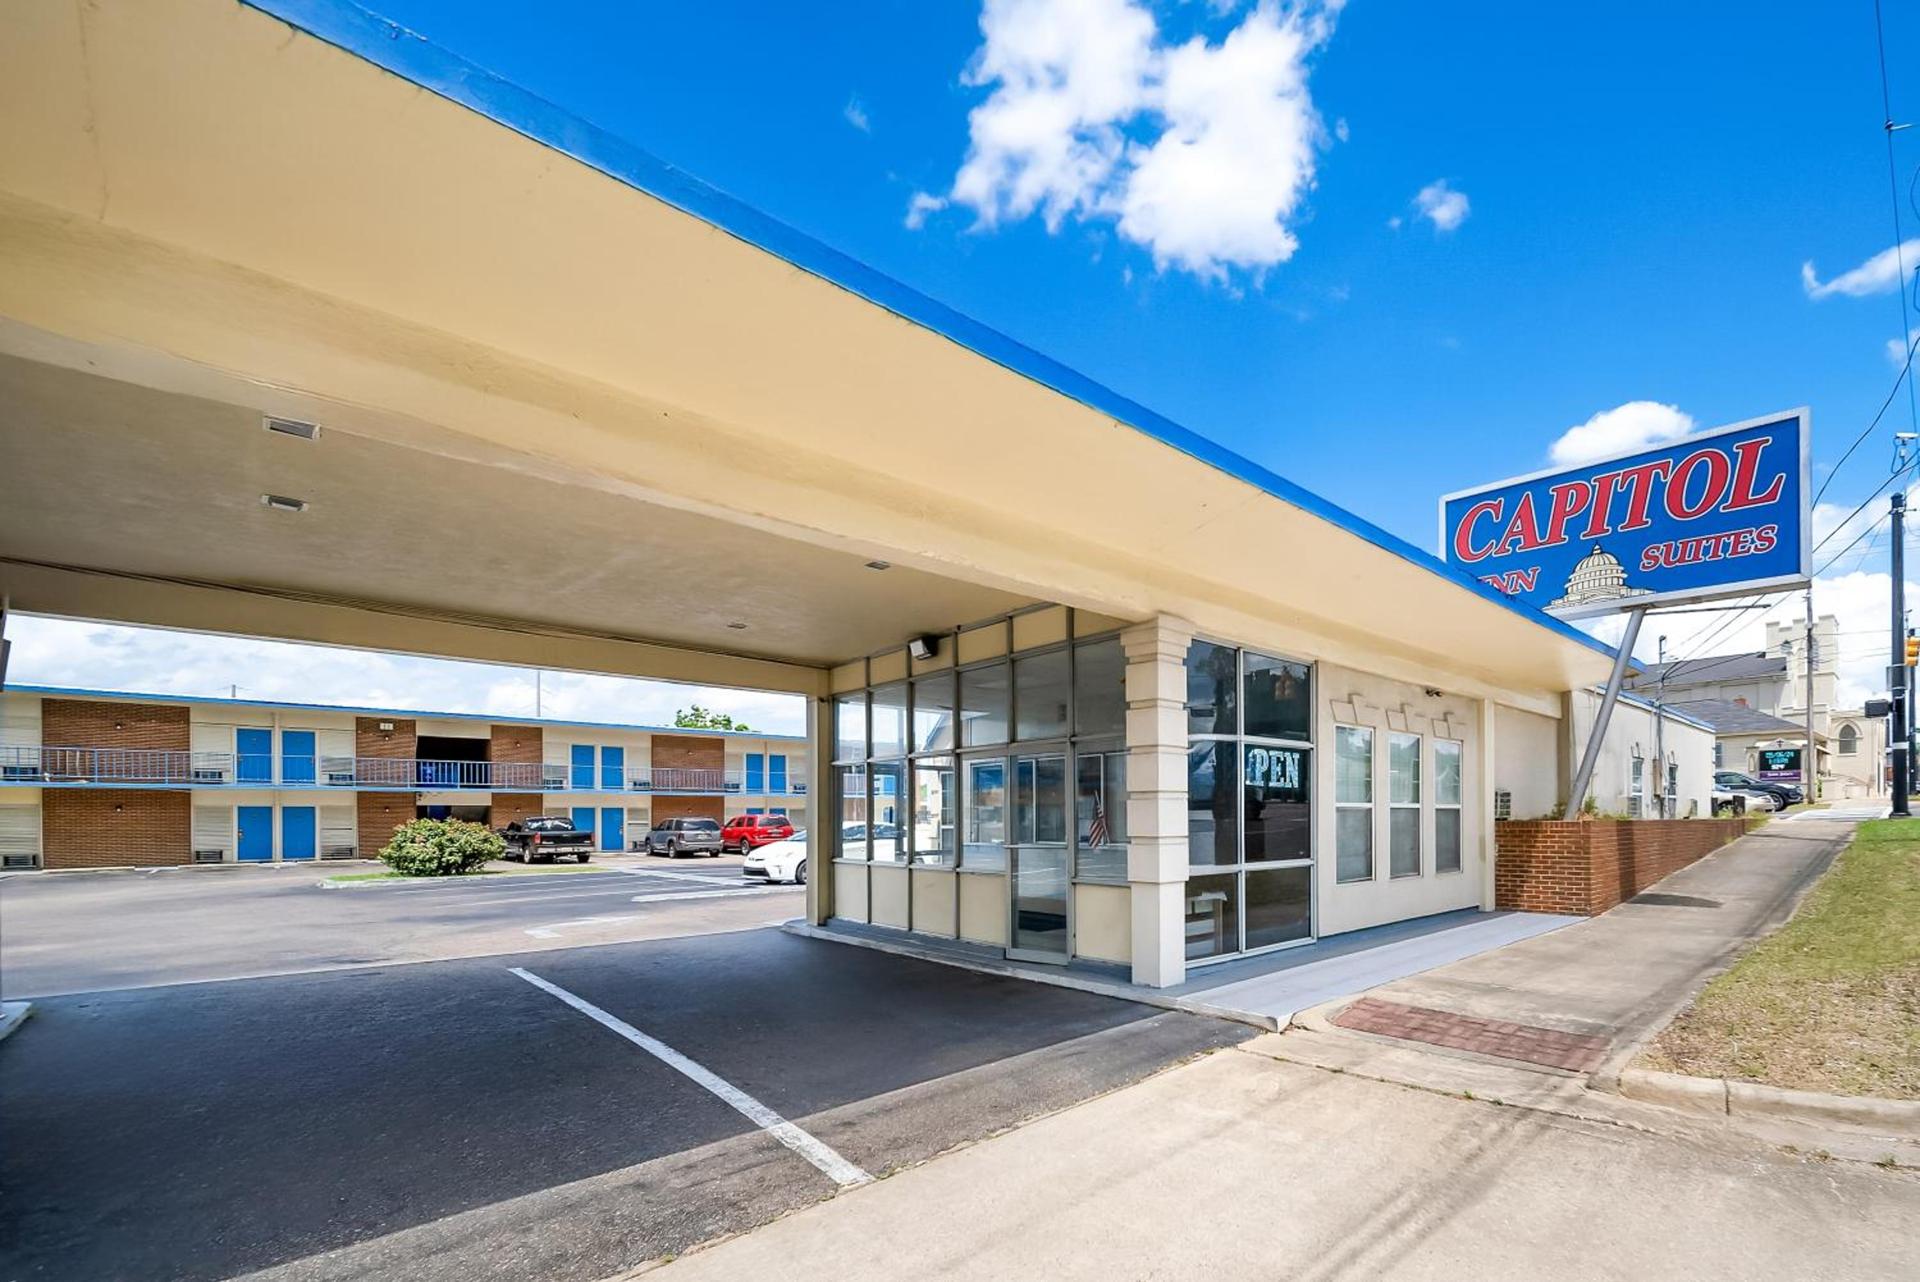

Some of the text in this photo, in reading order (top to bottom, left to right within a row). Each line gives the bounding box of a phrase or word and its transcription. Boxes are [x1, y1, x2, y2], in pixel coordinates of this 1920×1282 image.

[1454, 437, 1786, 562] CAPITOL
[1477, 524, 1778, 595] NN SUITES
[1246, 748, 1300, 788] PEN
